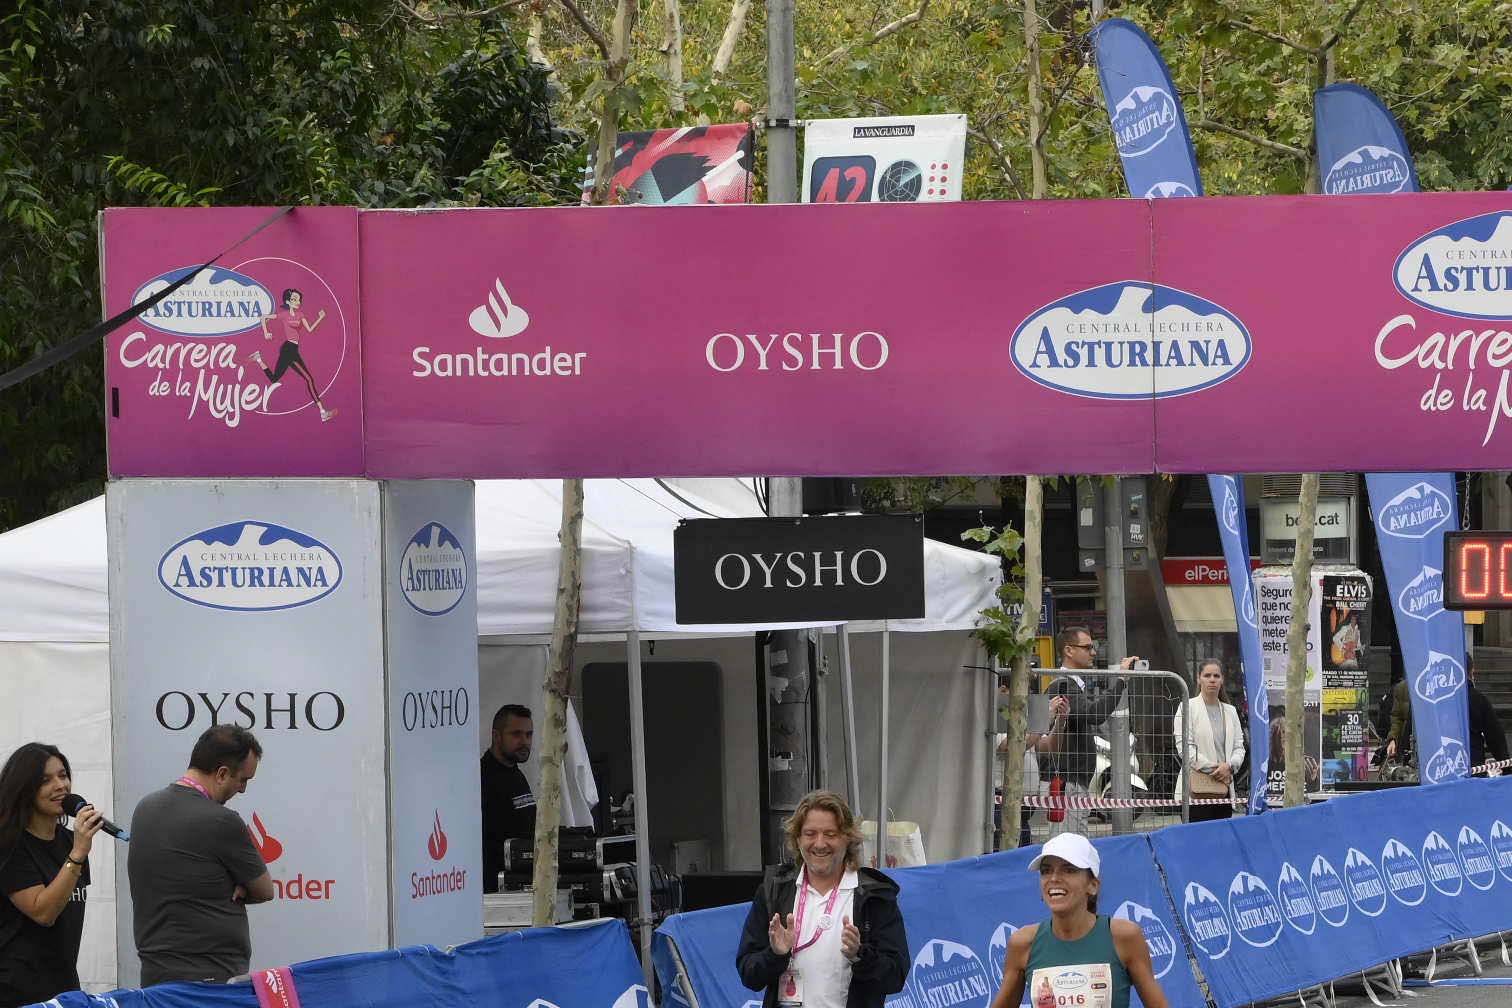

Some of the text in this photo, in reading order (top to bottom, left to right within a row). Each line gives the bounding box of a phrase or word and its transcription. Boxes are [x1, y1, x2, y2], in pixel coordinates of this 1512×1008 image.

[168, 289, 210, 298] ENTRAL
[1066, 321, 1225, 335] CENTRAL LECHERA
[119, 331, 237, 369] Carrera
[413, 346, 587, 378] Santander
[706, 331, 889, 372] OYSHO
[1029, 325, 1233, 369] ASTURIANA
[149, 366, 282, 427] de la Mujer
[1420, 372, 1454, 412] de
[1462, 372, 1487, 412] la
[1285, 512, 1340, 528] b.cat
[173, 554, 330, 588] ASTURIANA
[200, 551, 323, 561] CENTRAL LECHERA
[714, 549, 888, 590] OYSHO
[405, 561, 465, 593] ASTURIANA
[1336, 584, 1367, 598] ELVIS
[1261, 601, 1280, 613] que
[1261, 613, 1294, 625] quiere
[155, 691, 346, 732] OYSHO
[402, 686, 470, 732] OYSHO
[1347, 714, 1359, 725] 30
[1268, 770, 1287, 781] JOS
[411, 865, 467, 899] Santander
